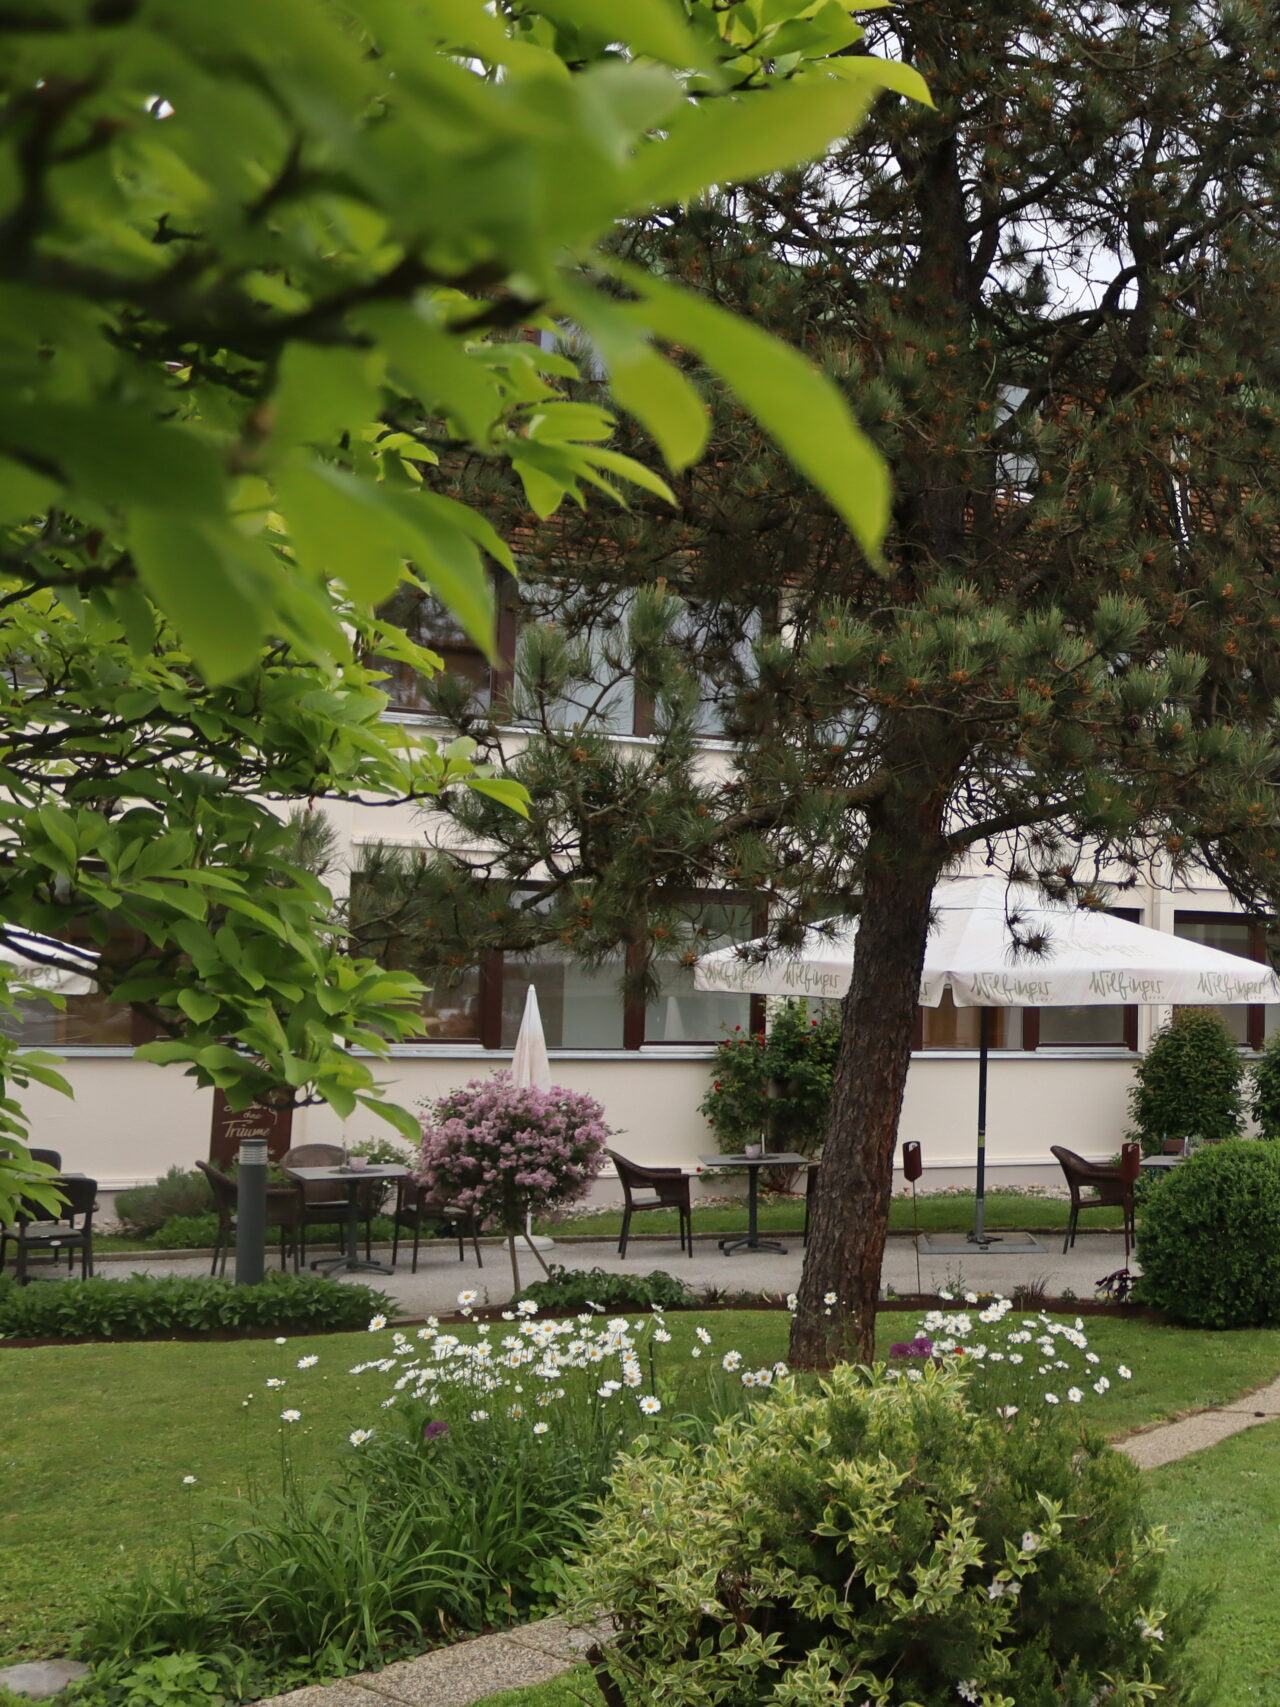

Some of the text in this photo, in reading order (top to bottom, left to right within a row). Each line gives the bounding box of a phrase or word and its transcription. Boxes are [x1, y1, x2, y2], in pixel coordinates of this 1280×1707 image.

[784, 961, 841, 994] Wilfinger
[971, 972, 1052, 1001] Wilfinger
[1089, 970, 1164, 1001] Wilfinger
